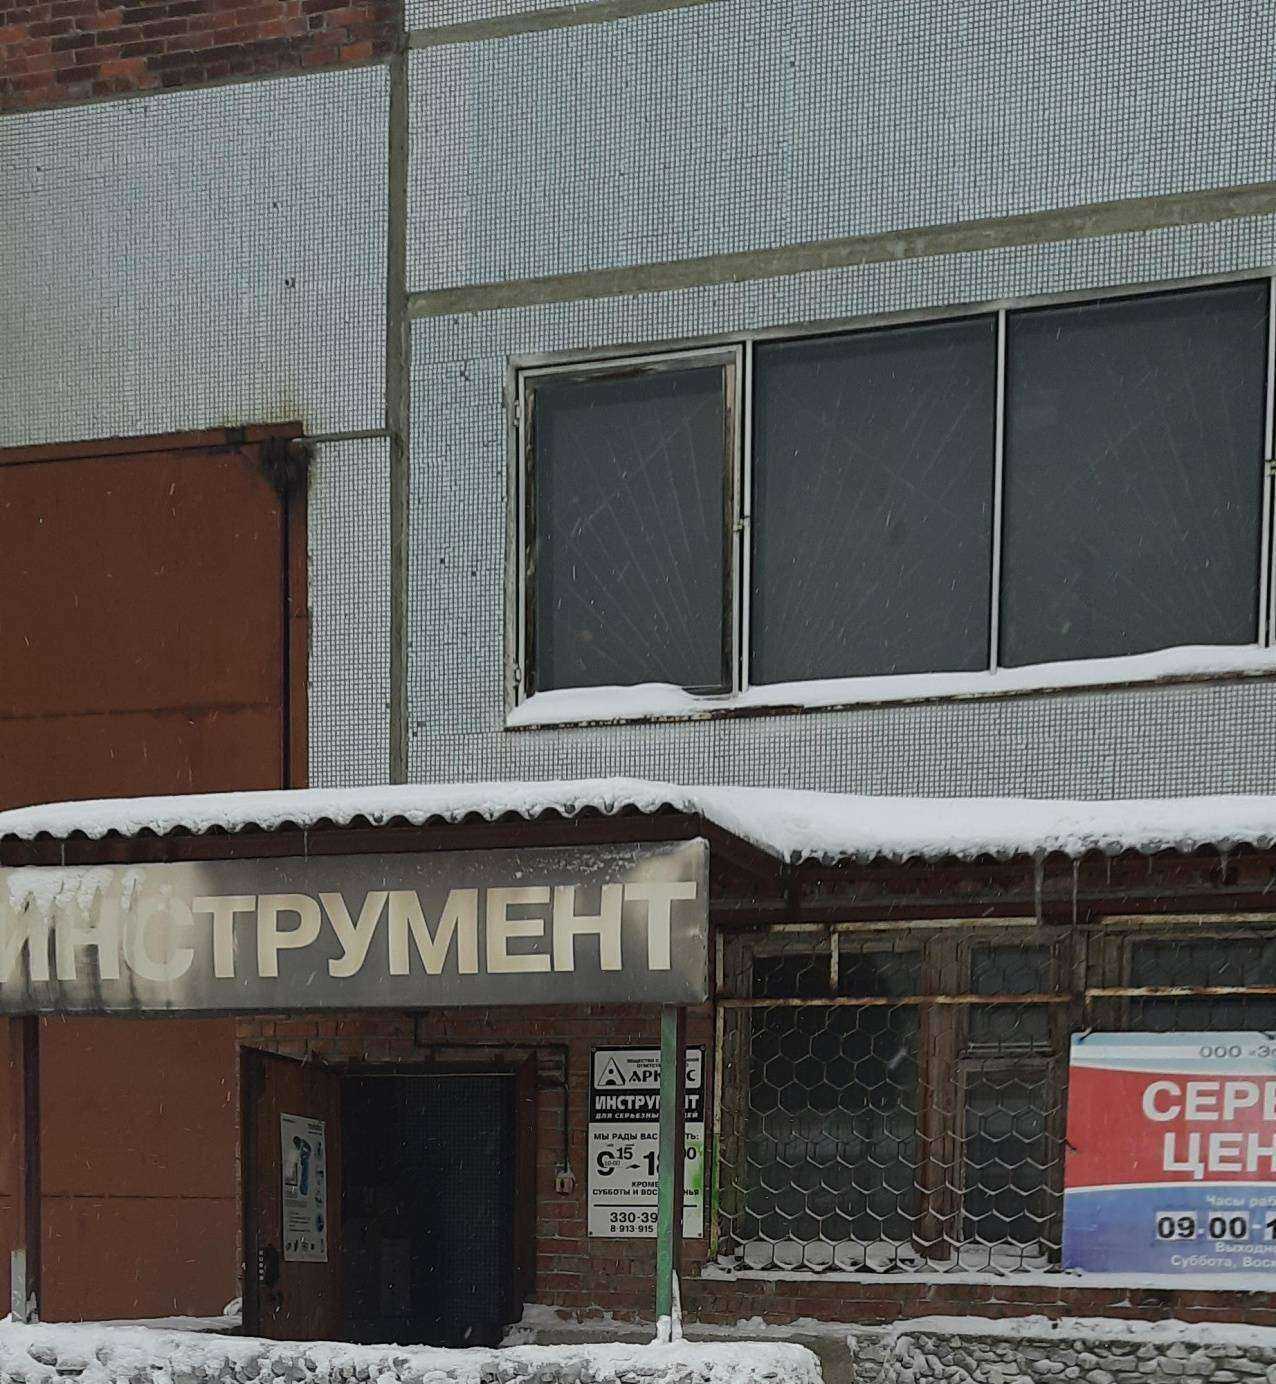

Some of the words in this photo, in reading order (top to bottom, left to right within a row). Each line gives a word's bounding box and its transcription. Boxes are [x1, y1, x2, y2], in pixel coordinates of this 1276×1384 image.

[0, 881, 697, 982] ИНСТРУМЕНТ
[628, 1069, 696, 1082] АРКС
[612, 1133, 637, 1141] РАДЫ
